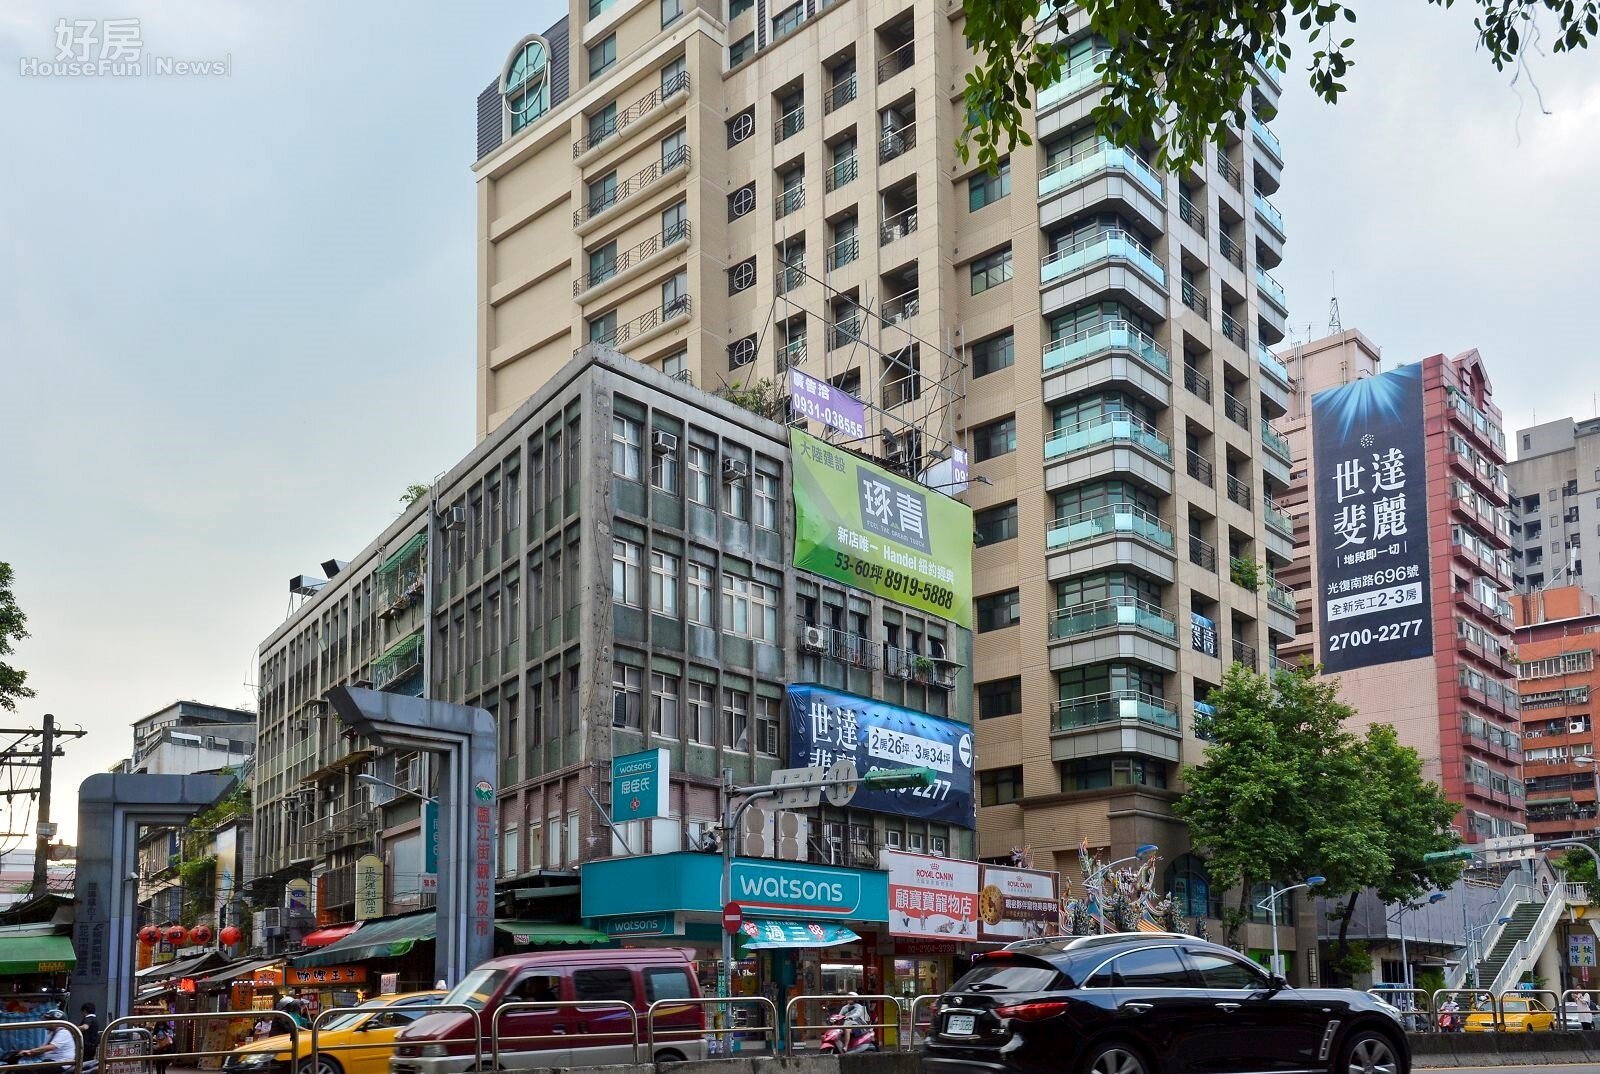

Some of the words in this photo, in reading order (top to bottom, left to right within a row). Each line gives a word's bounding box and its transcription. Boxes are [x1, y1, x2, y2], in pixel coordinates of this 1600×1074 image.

[794, 393, 863, 439] 0931-038555
[800, 440, 847, 475] 大陸建設
[1332, 447, 1407, 504] 世達
[863, 480, 924, 539] 琢青
[1333, 492, 1408, 550] 斐麗
[837, 526, 879, 553] 新店唯一
[883, 544, 917, 571] Handel
[1343, 543, 1400, 566] 地段即一切
[834, 551, 884, 585] 53-60坪
[884, 567, 954, 610] 8919-5888
[1327, 564, 1420, 595] 光復南路696號
[1331, 588, 1417, 617] 全新完工2-3房
[1329, 619, 1423, 652] 2700-2277
[808, 702, 858, 751] 世達
[619, 762, 652, 774] watsons
[621, 777, 650, 795] 屈臣氏
[475, 805, 490, 937] 臨江街觀光夜市
[916, 869, 935, 879] ROYAL
[935, 871, 954, 881] CANIN
[739, 874, 843, 902] watsons
[895, 888, 973, 915] 顧寶寶寵物店
[614, 919, 658, 931] watsons
